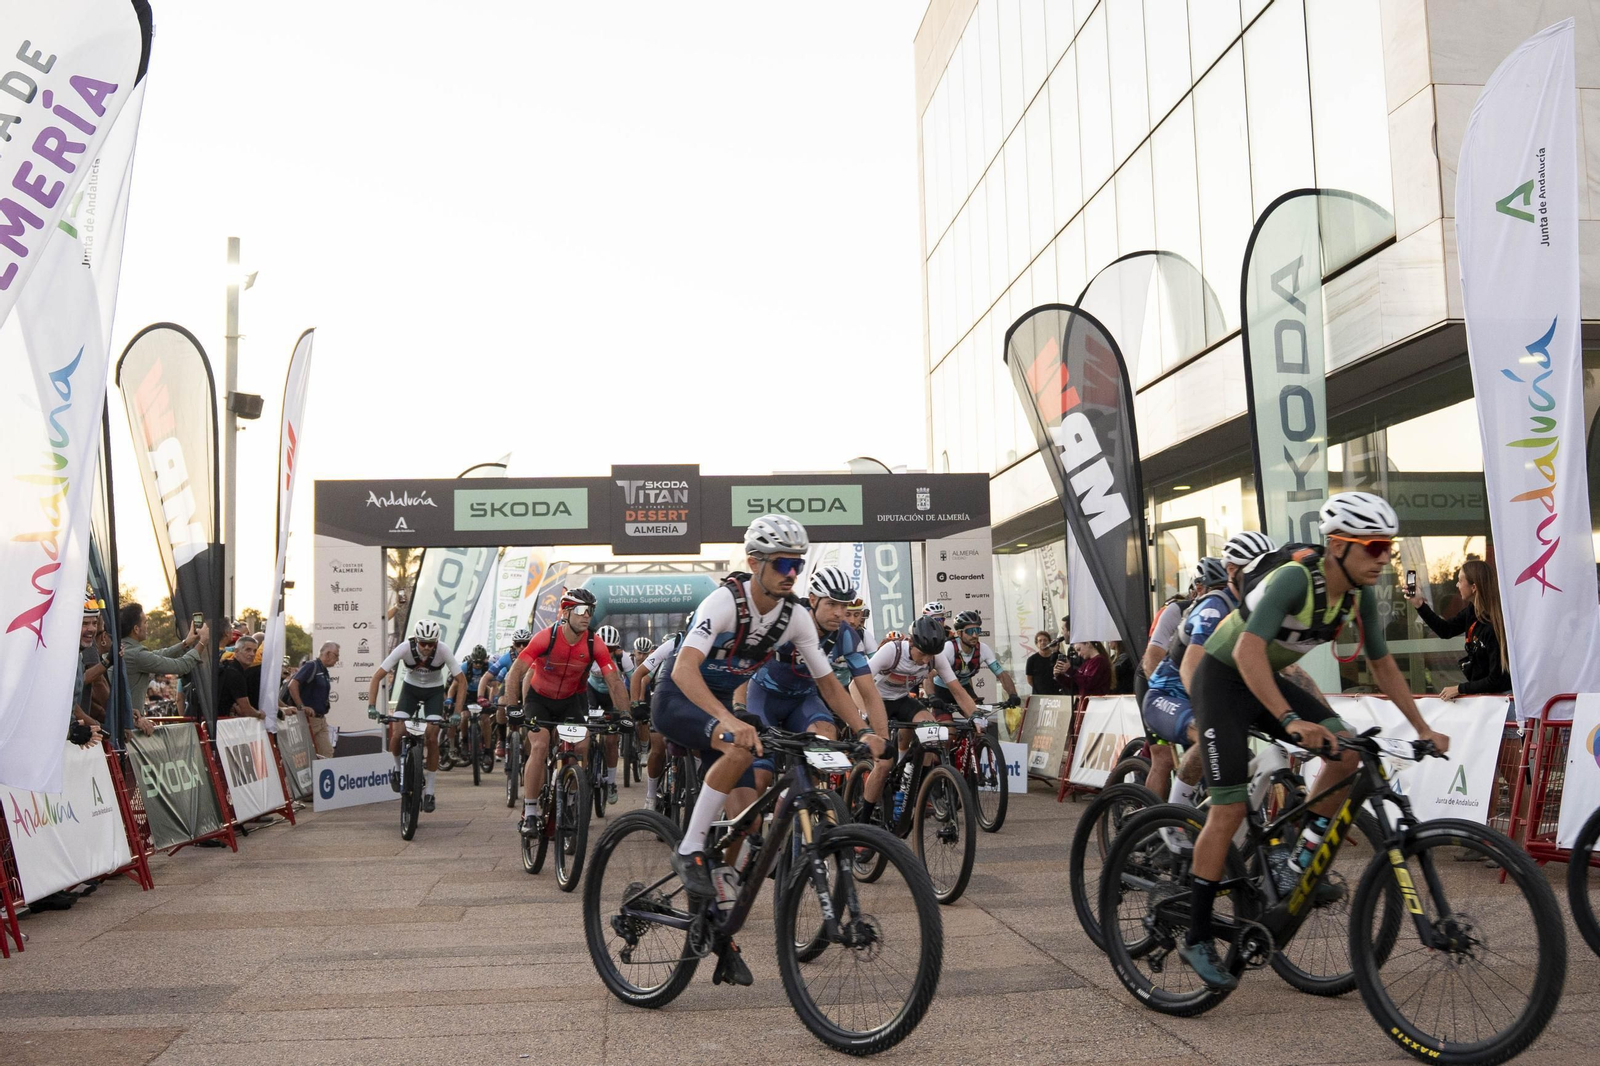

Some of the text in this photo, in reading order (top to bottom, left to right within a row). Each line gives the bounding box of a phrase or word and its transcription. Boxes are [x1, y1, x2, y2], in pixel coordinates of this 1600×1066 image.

[0, 39, 57, 104] DE
[1536, 147, 1550, 247] Junta de Andalucía
[82, 158, 101, 269] Junta de Andalucía
[1500, 313, 1563, 598] Andalucía
[645, 481, 689, 489] SKODA
[365, 490, 438, 508] Andalucía
[615, 480, 689, 505] TITAN
[470, 501, 573, 518] SKODA
[747, 497, 848, 513] SKODA
[625, 509, 689, 522] DESERT
[877, 513, 971, 522] DIPUTACIÓN DE ALMERÍA
[633, 523, 679, 534] ALMERÍA
[948, 573, 985, 581] Cleardent
[608, 583, 693, 596] UNIVERSAE
[639, 596, 671, 604] Superior
[928, 726, 938, 735] 47
[818, 753, 834, 762] 23
[338, 768, 395, 791] Cleardent
[1455, 799, 1479, 807] Andalucía
